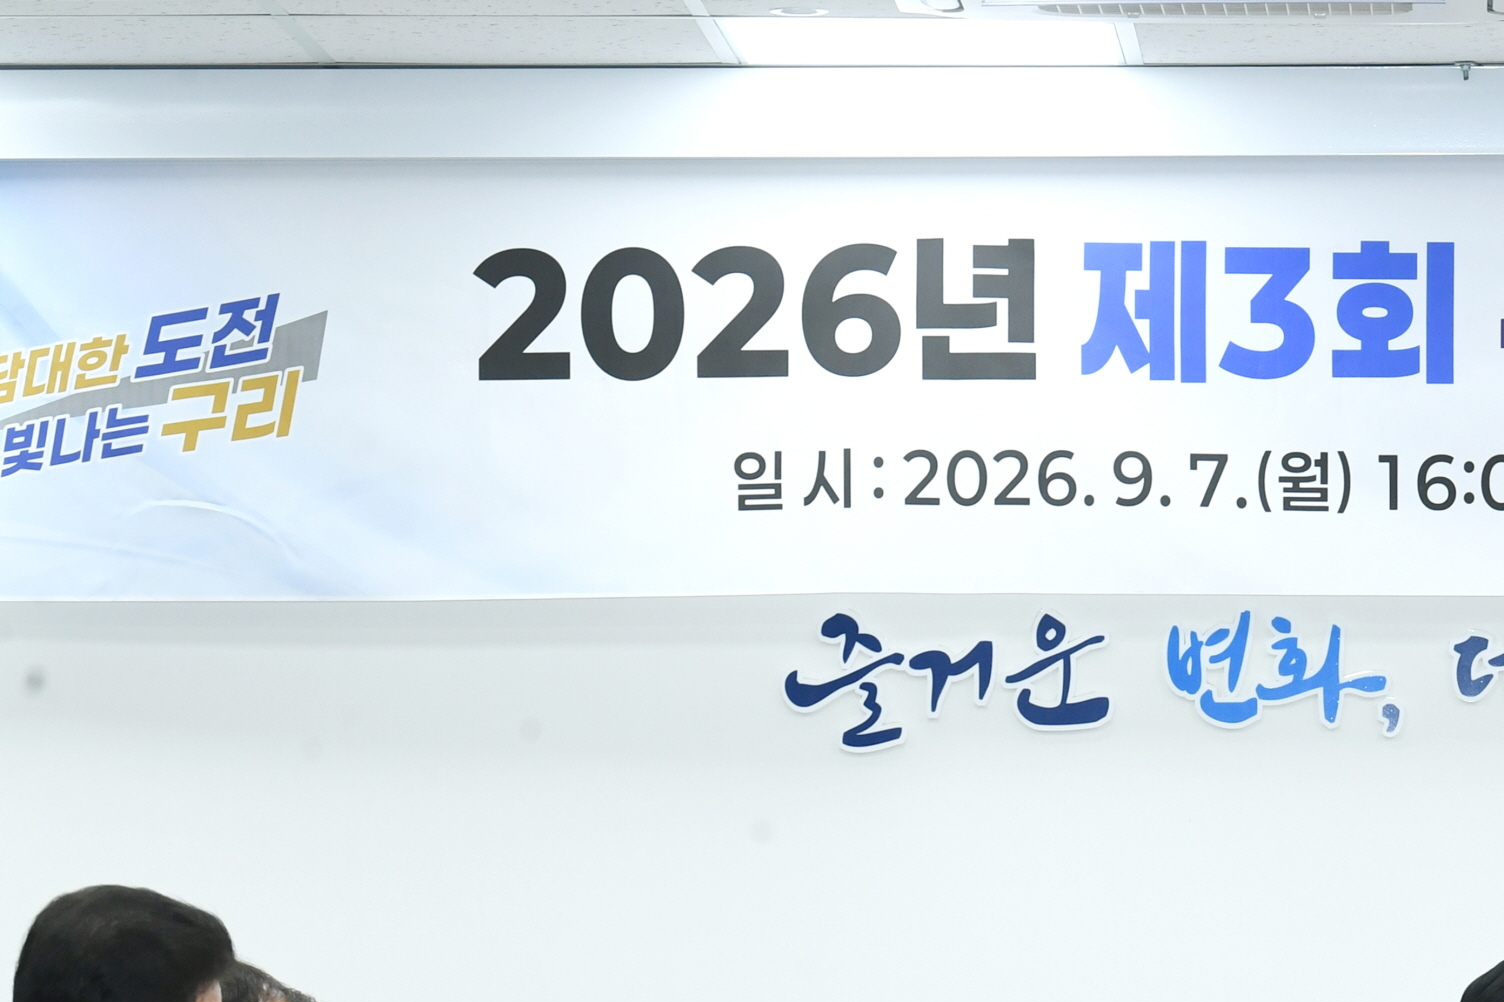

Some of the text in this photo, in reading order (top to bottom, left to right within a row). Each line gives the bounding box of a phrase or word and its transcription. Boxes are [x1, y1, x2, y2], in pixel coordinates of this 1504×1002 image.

[134, 293, 280, 379] 도전
[473, 238, 1036, 381] 2026년
[1082, 240, 1454, 384] 제3회
[1, 369, 301, 477] 빛나는 구리
[903, 449, 1094, 507] 2026.
[1114, 451, 1170, 507] 9.
[785, 612, 1110, 748] 즐거운
[1166, 610, 1400, 732] 변화,
